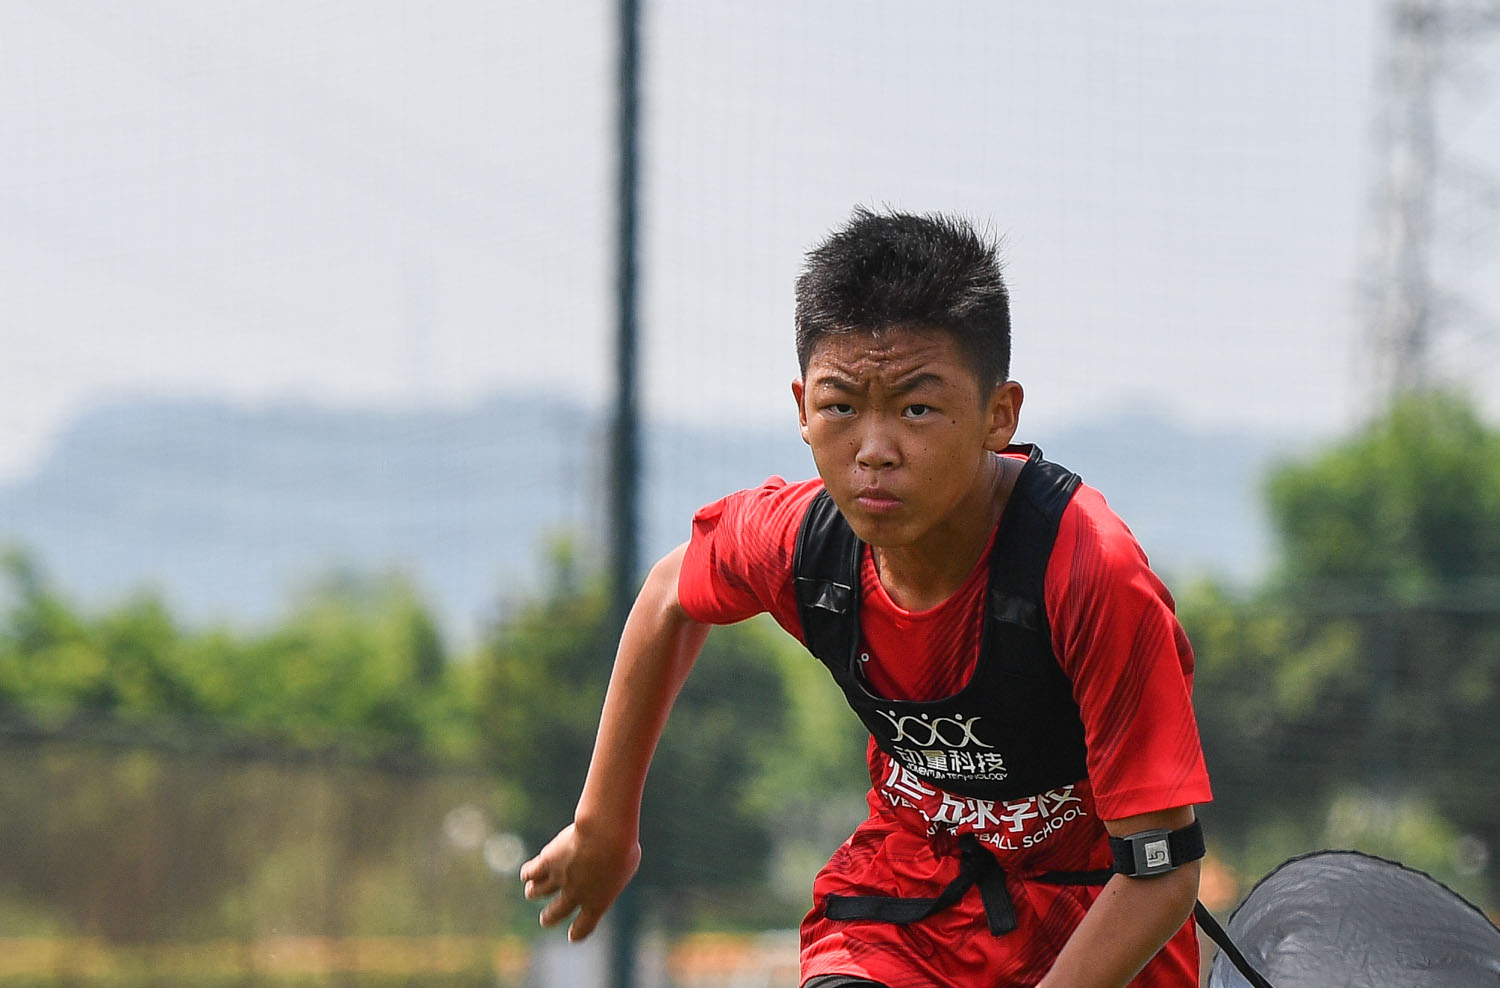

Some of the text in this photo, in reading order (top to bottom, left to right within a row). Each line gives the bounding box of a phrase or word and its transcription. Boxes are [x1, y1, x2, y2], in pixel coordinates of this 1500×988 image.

[893, 745, 1007, 774] 动量科技
[1023, 806, 1087, 848] SCHOOL
